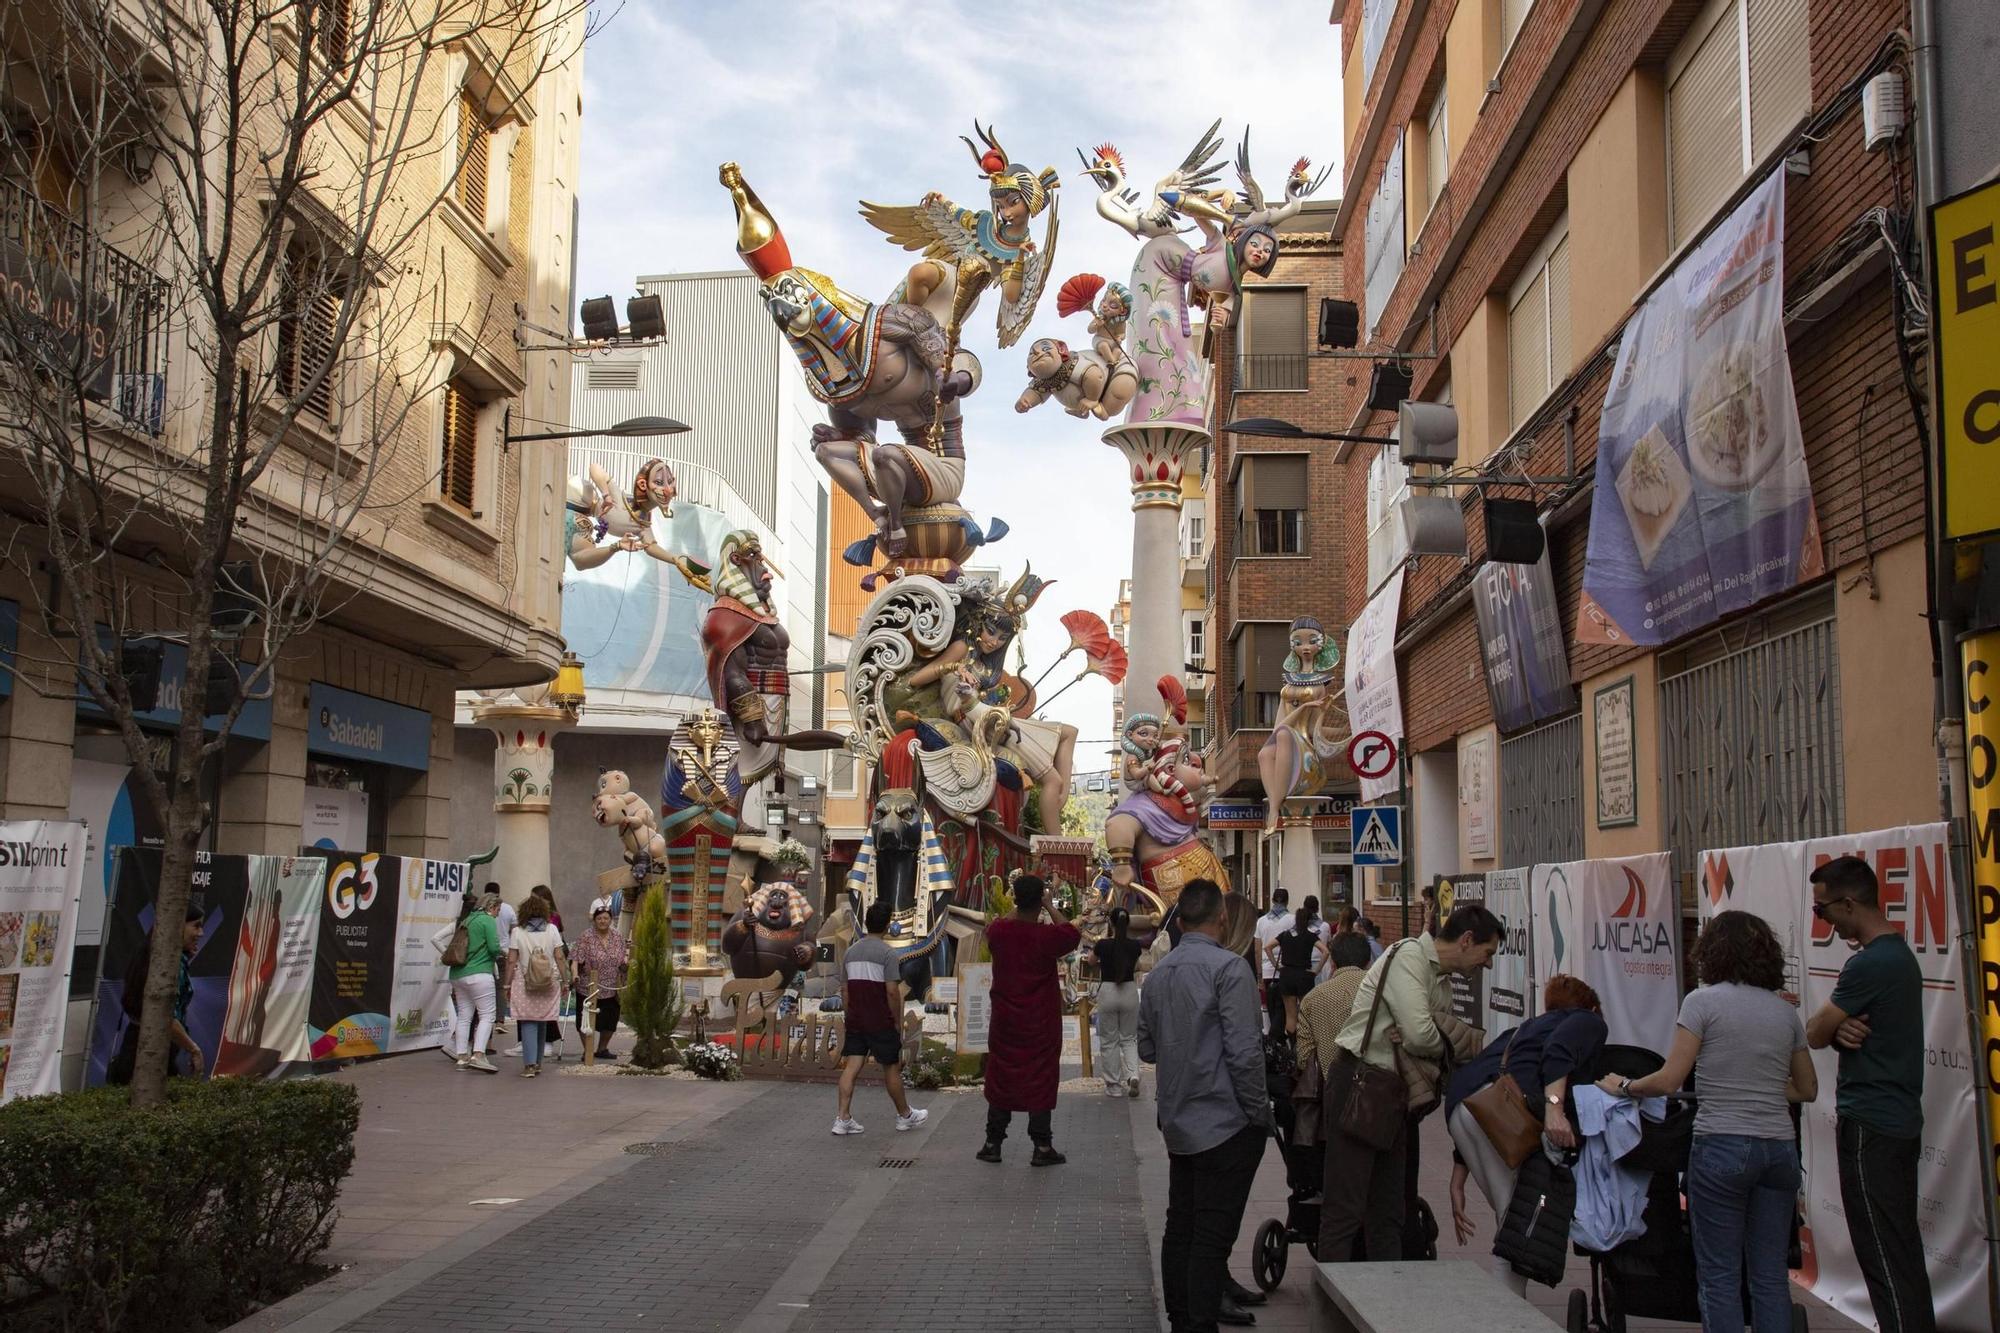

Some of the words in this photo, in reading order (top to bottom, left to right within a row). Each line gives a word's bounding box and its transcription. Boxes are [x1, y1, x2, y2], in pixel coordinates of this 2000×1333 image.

[329, 713, 384, 752] Sabadell
[1210, 807, 1261, 819] ricardo
[1314, 817, 1352, 828] auto-e
[328, 852, 380, 919] G3
[425, 860, 464, 893] EMSI
[335, 924, 368, 937] PUBLICITAT
[1592, 921, 1672, 954] JUNCASA
